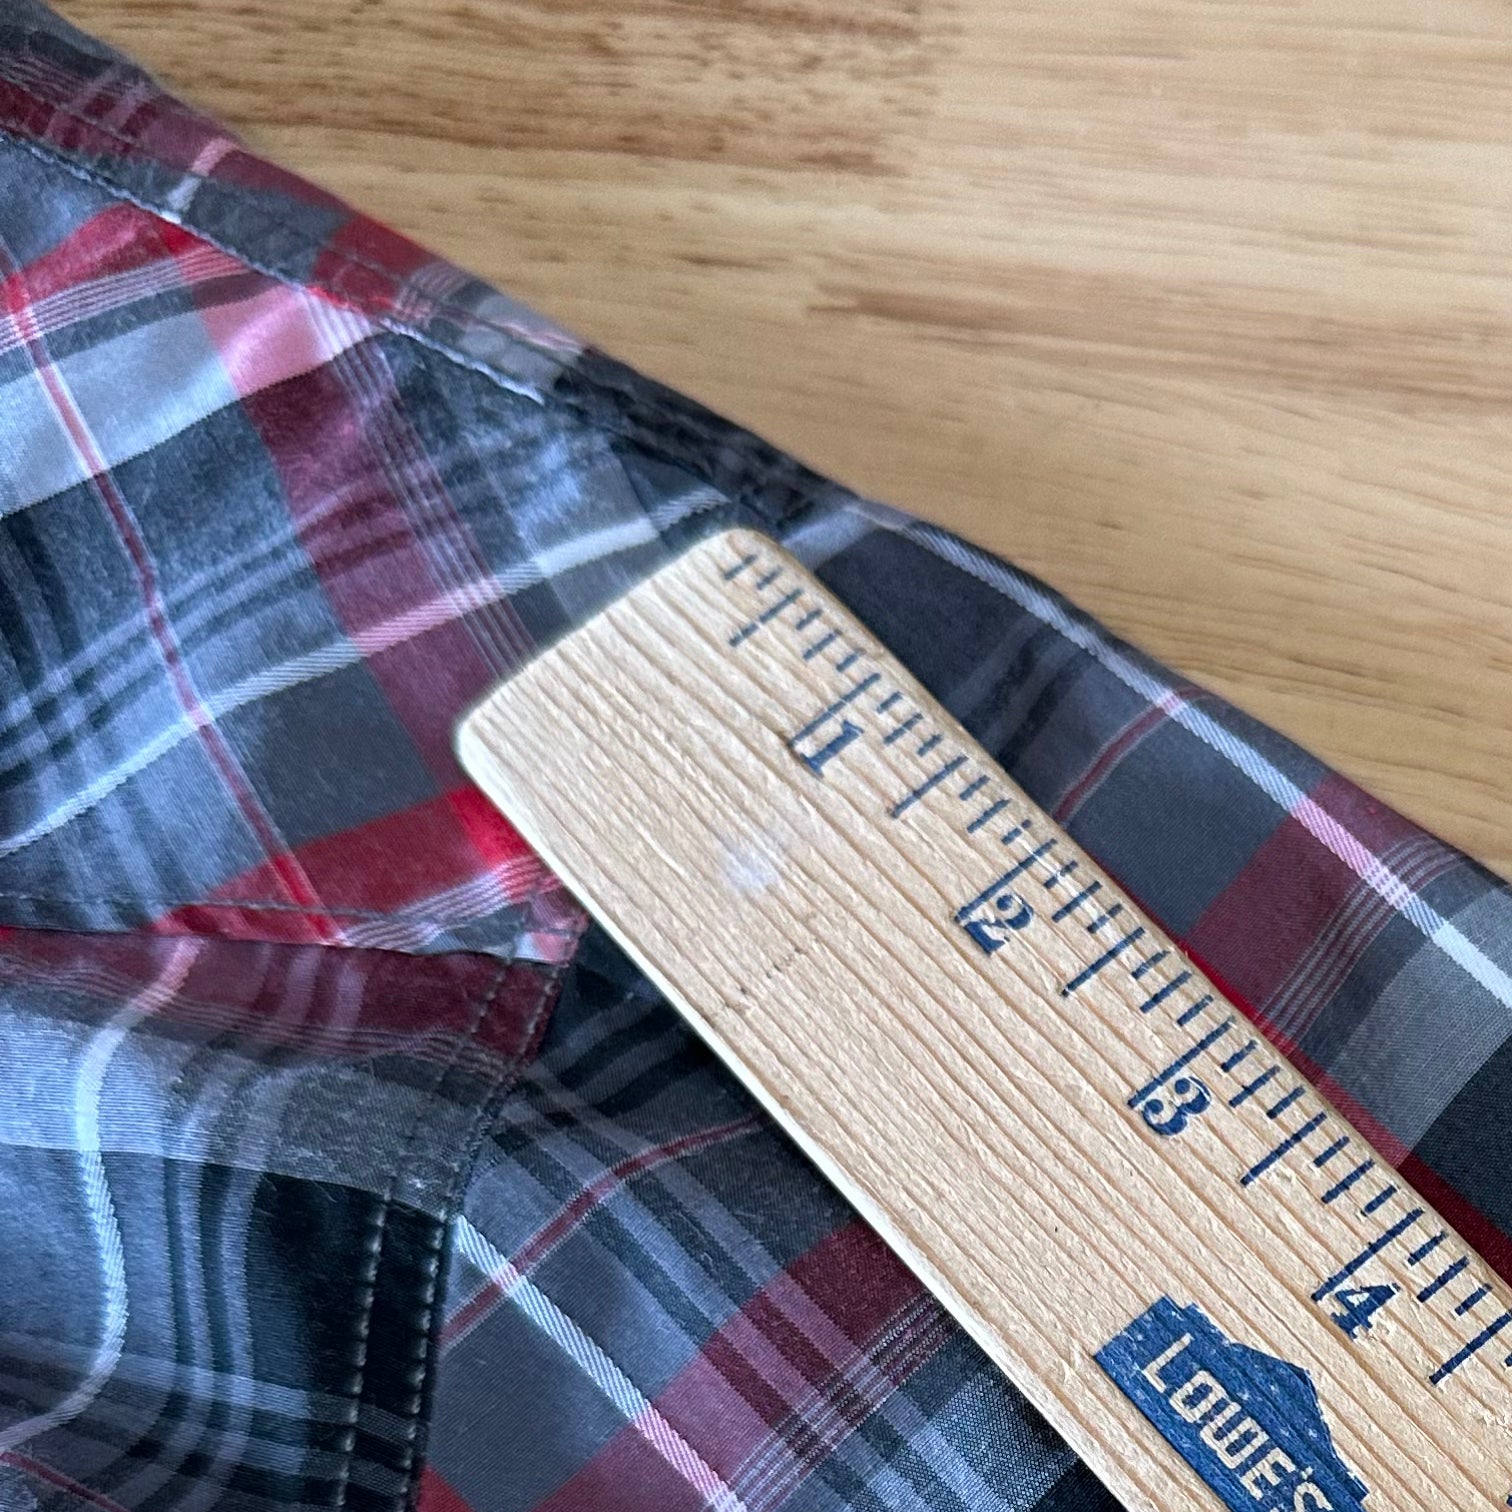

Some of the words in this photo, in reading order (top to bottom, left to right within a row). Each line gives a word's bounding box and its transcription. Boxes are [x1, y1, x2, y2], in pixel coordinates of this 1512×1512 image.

[796, 719, 860, 777] 1
[962, 894, 1034, 955] 2
[1139, 1075, 1211, 1137] 3
[1325, 1283, 1398, 1339] 4
